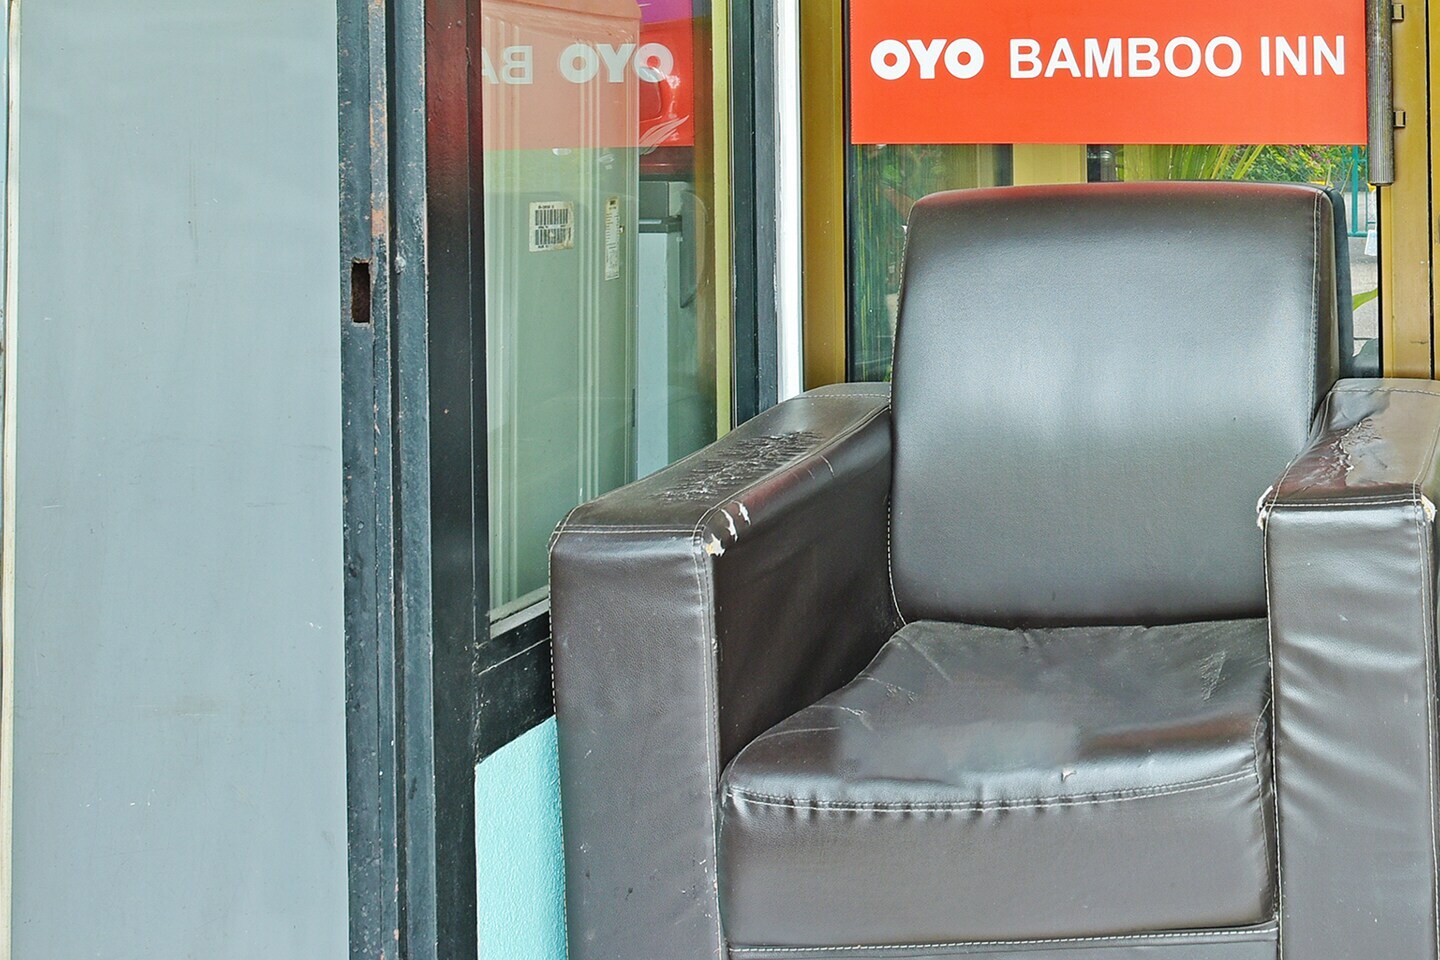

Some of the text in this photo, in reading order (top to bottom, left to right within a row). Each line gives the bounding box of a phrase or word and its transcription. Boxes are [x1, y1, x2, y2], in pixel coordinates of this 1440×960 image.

[870, 34, 1345, 80] OYO BAMBOO INN
